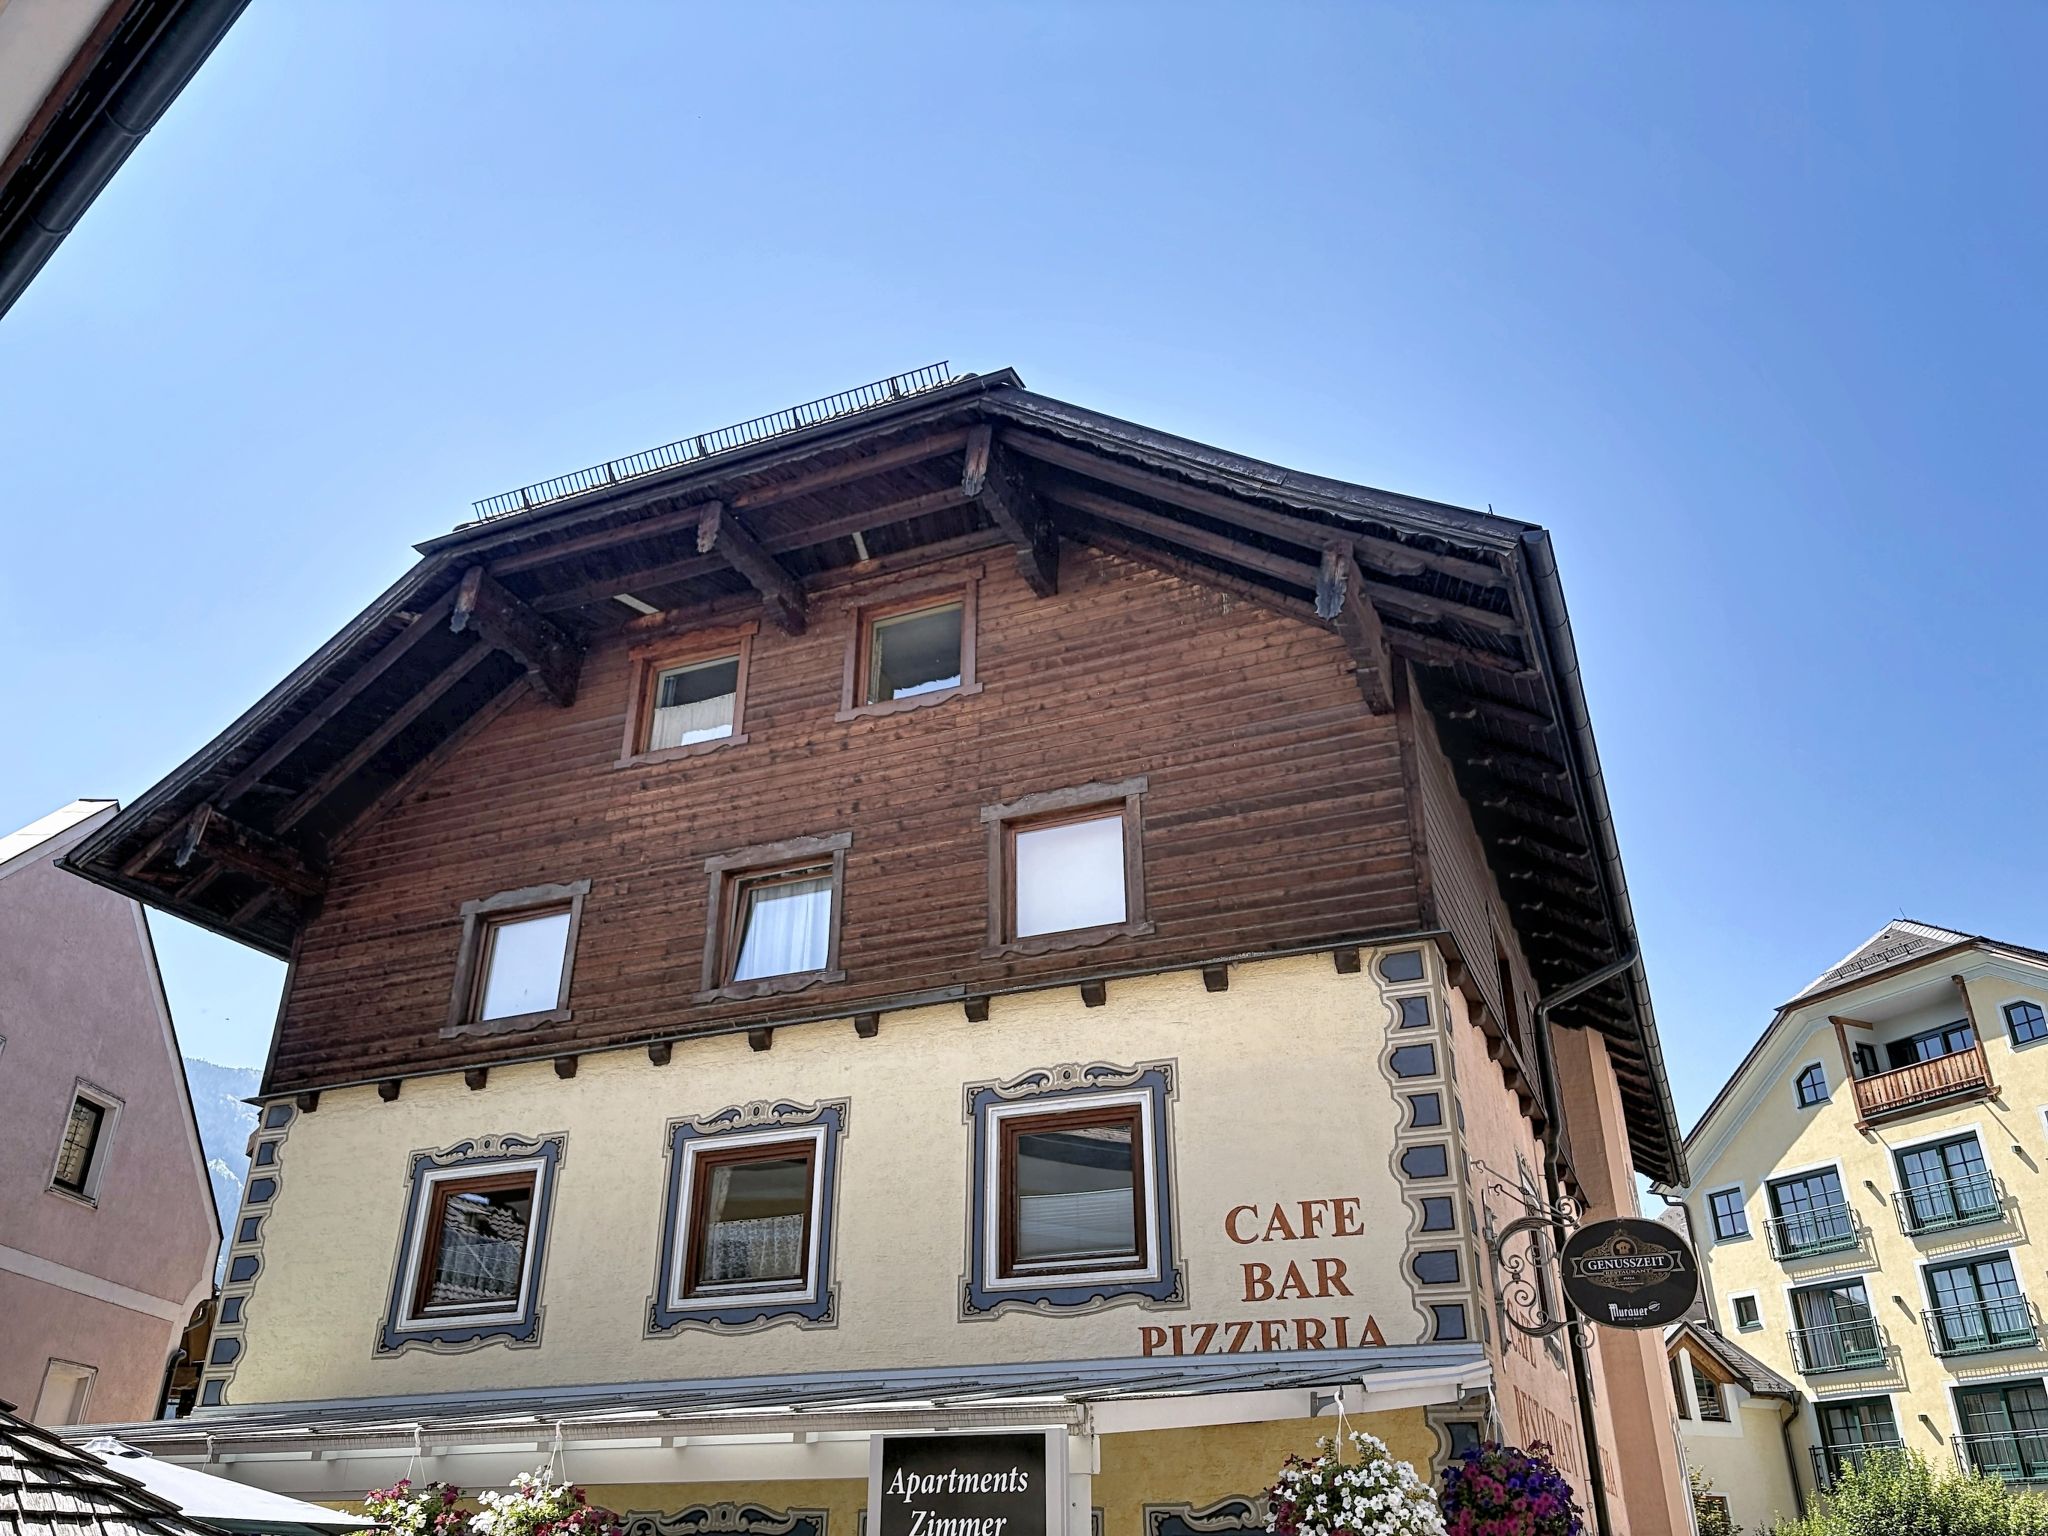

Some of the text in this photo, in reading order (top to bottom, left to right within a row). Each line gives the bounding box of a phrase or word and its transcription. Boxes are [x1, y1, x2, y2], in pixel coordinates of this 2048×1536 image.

[1225, 1197, 1364, 1244] CAFE
[1240, 1258, 1354, 1302] BAR
[1588, 1255, 1665, 1271] GENUSSZEIT
[1608, 1303, 1648, 1322] Murauer
[1138, 1314, 1387, 1357] PIZZERIA
[886, 1466, 1028, 1503] Apartments
[908, 1510, 1007, 1536] Zimmer
